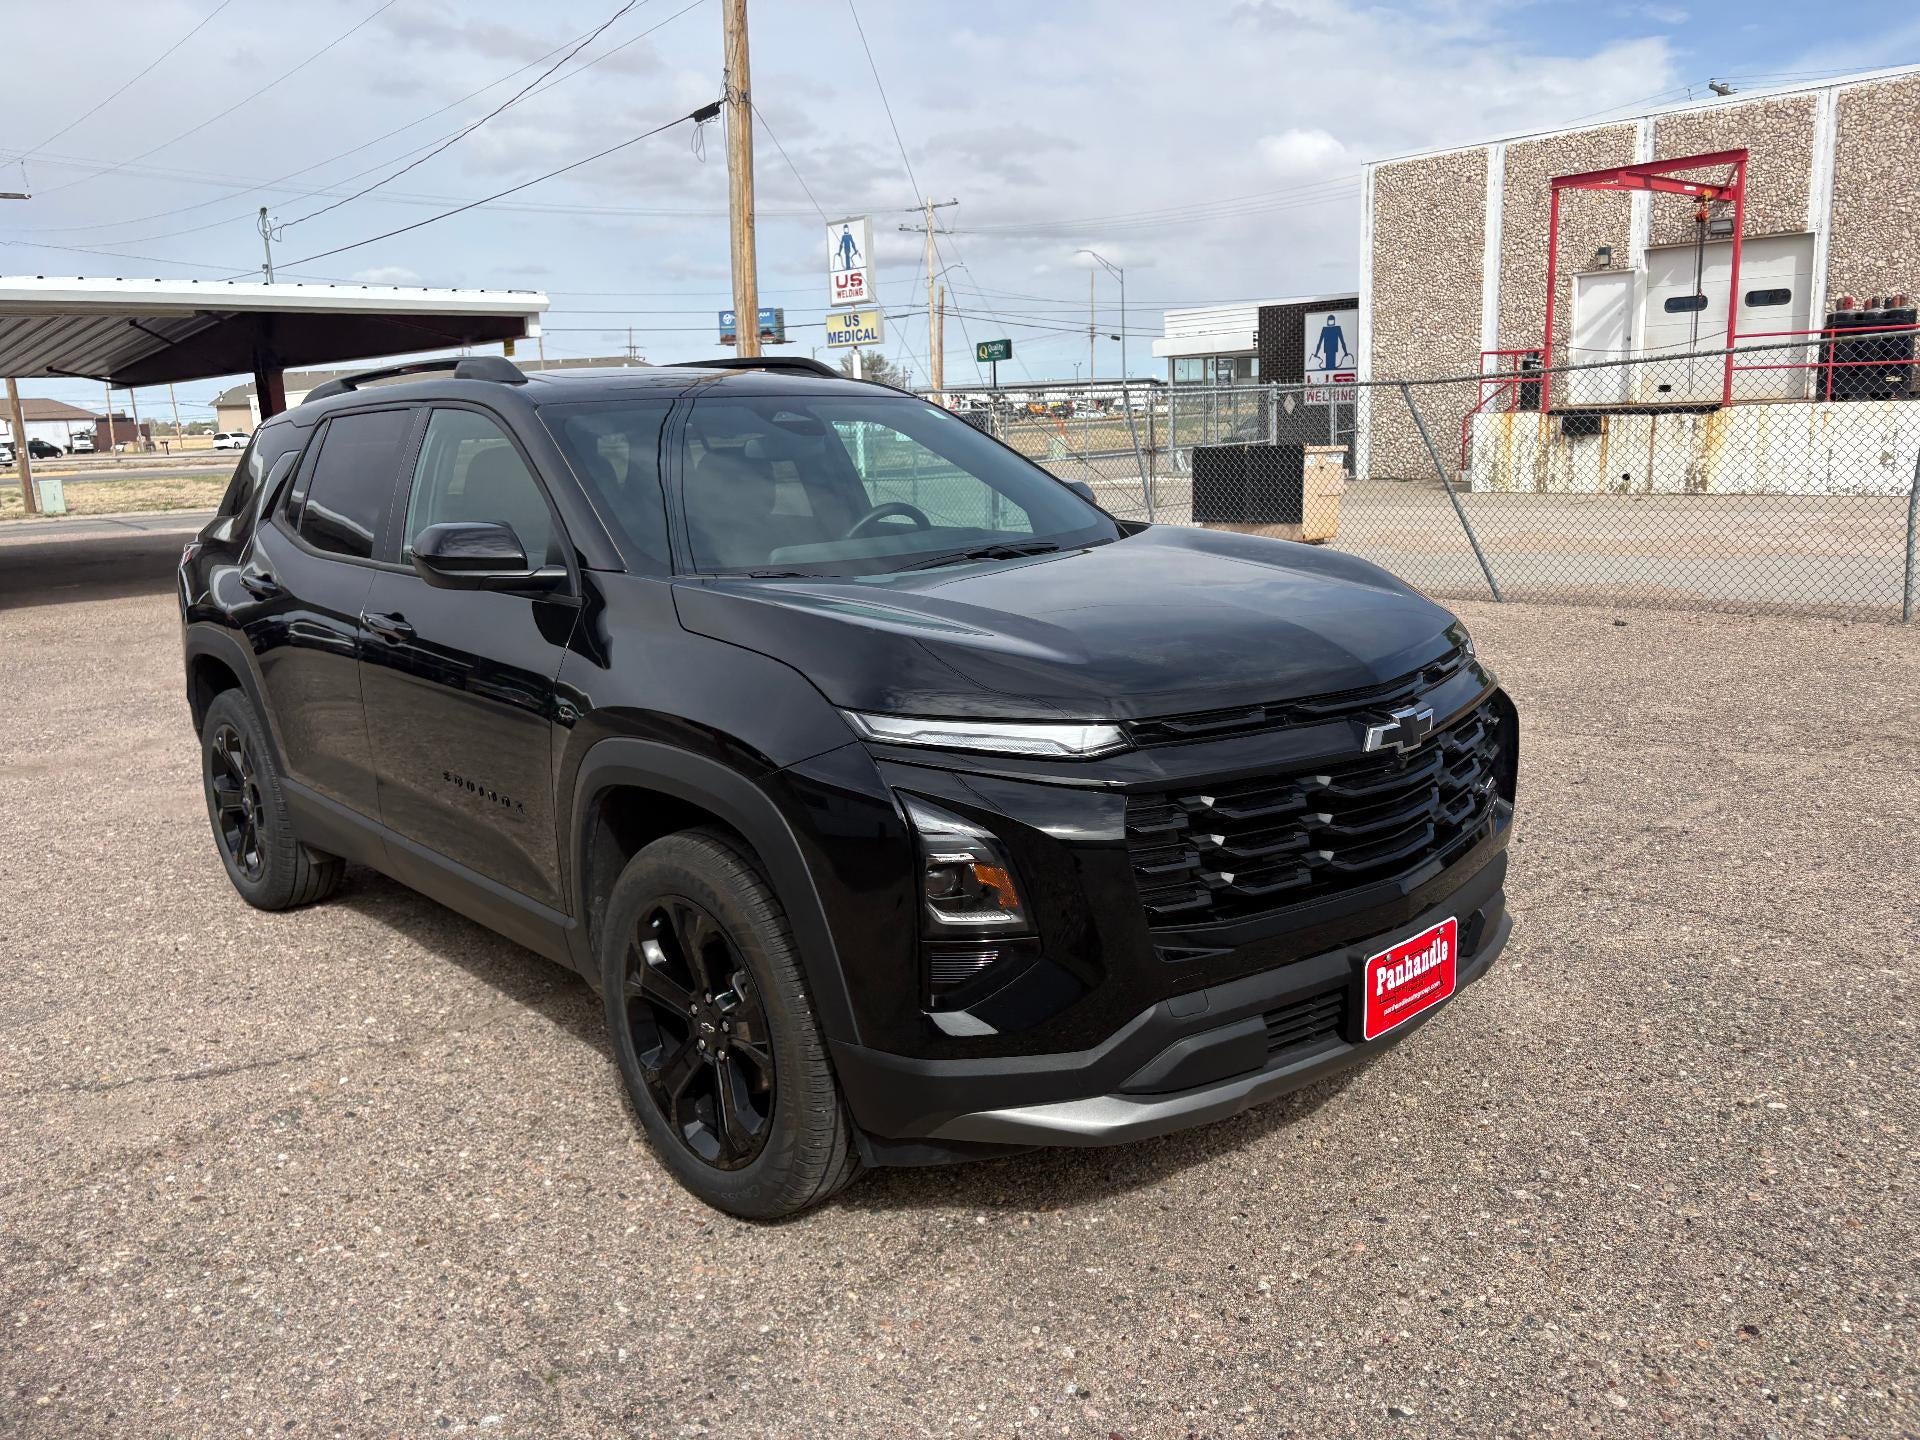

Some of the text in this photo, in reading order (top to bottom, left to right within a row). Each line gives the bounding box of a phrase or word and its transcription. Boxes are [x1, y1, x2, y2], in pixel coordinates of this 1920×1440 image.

[836, 272, 863, 289] US
[836, 288, 864, 299] WELDING
[844, 314, 860, 328] US
[827, 328, 878, 345] MEDICAL
[987, 343, 1005, 353] Quality
[1376, 937, 1448, 996] Panhandle
